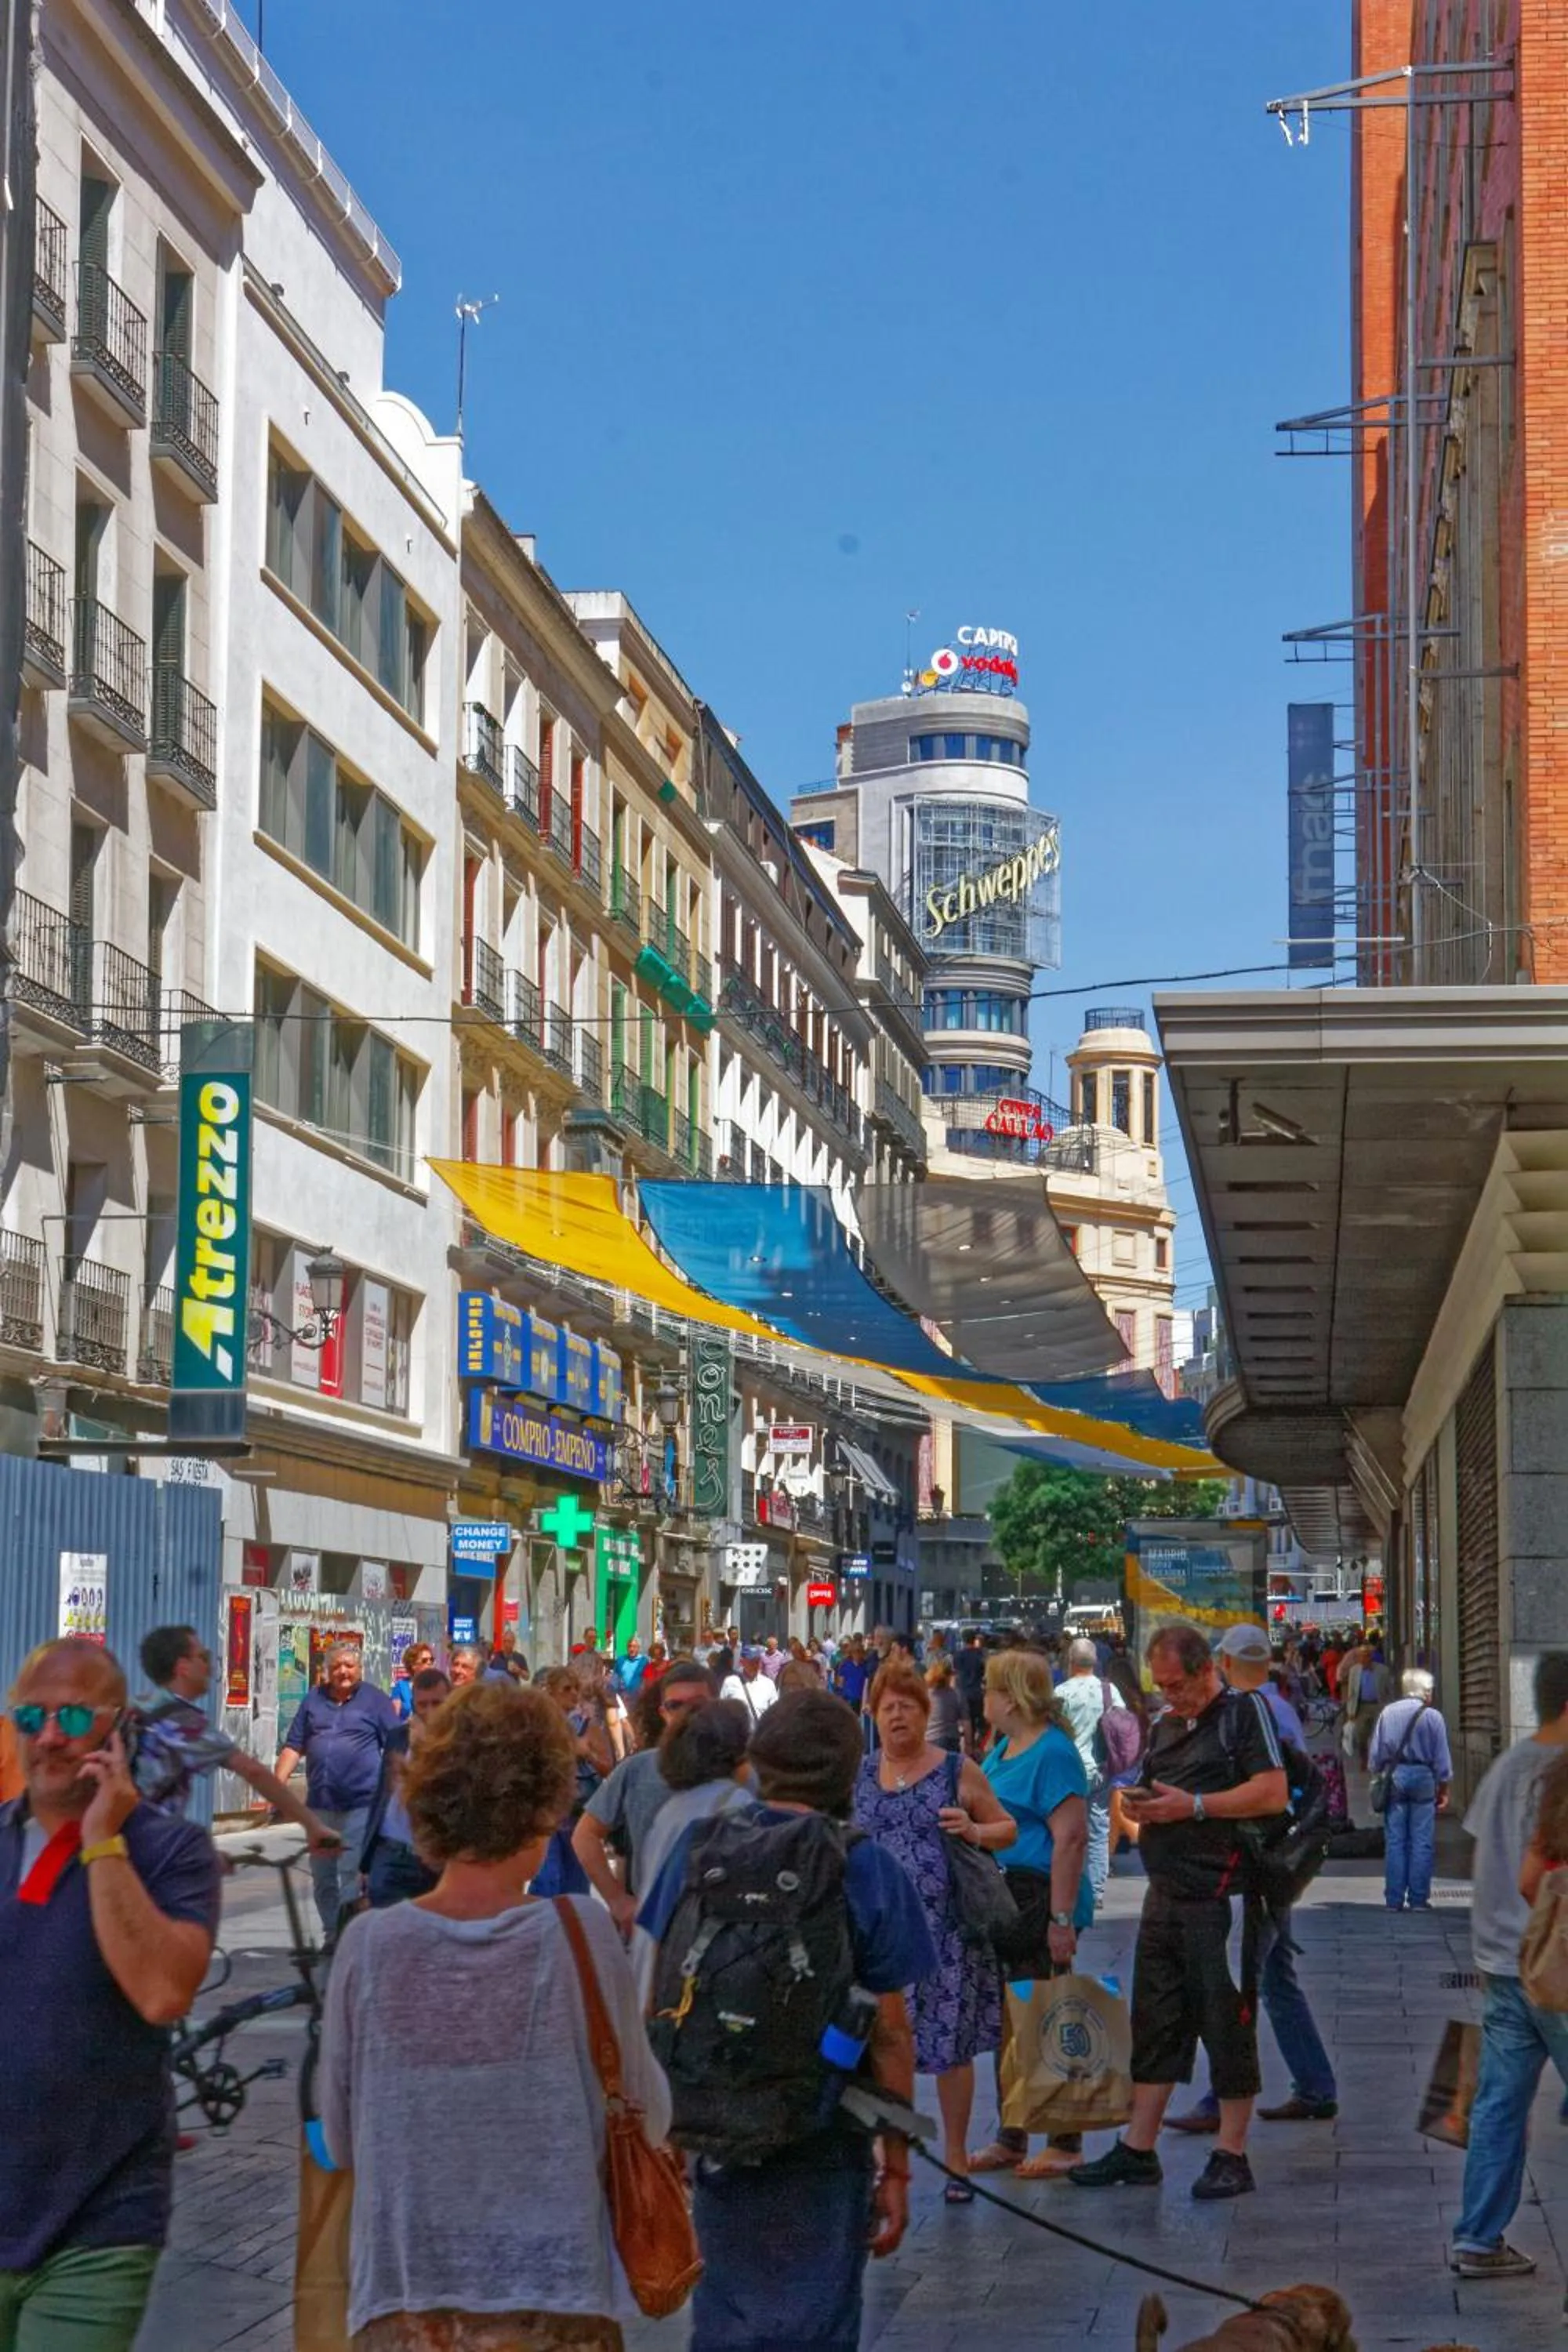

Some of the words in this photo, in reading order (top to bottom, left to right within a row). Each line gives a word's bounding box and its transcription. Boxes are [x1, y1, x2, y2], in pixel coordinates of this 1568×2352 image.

[924, 825, 1060, 938] Schweppes
[983, 1112, 1054, 1142] CALLAO
[455, 1526, 506, 1537] CHANGE
[458, 1539, 503, 1550] MONEY
